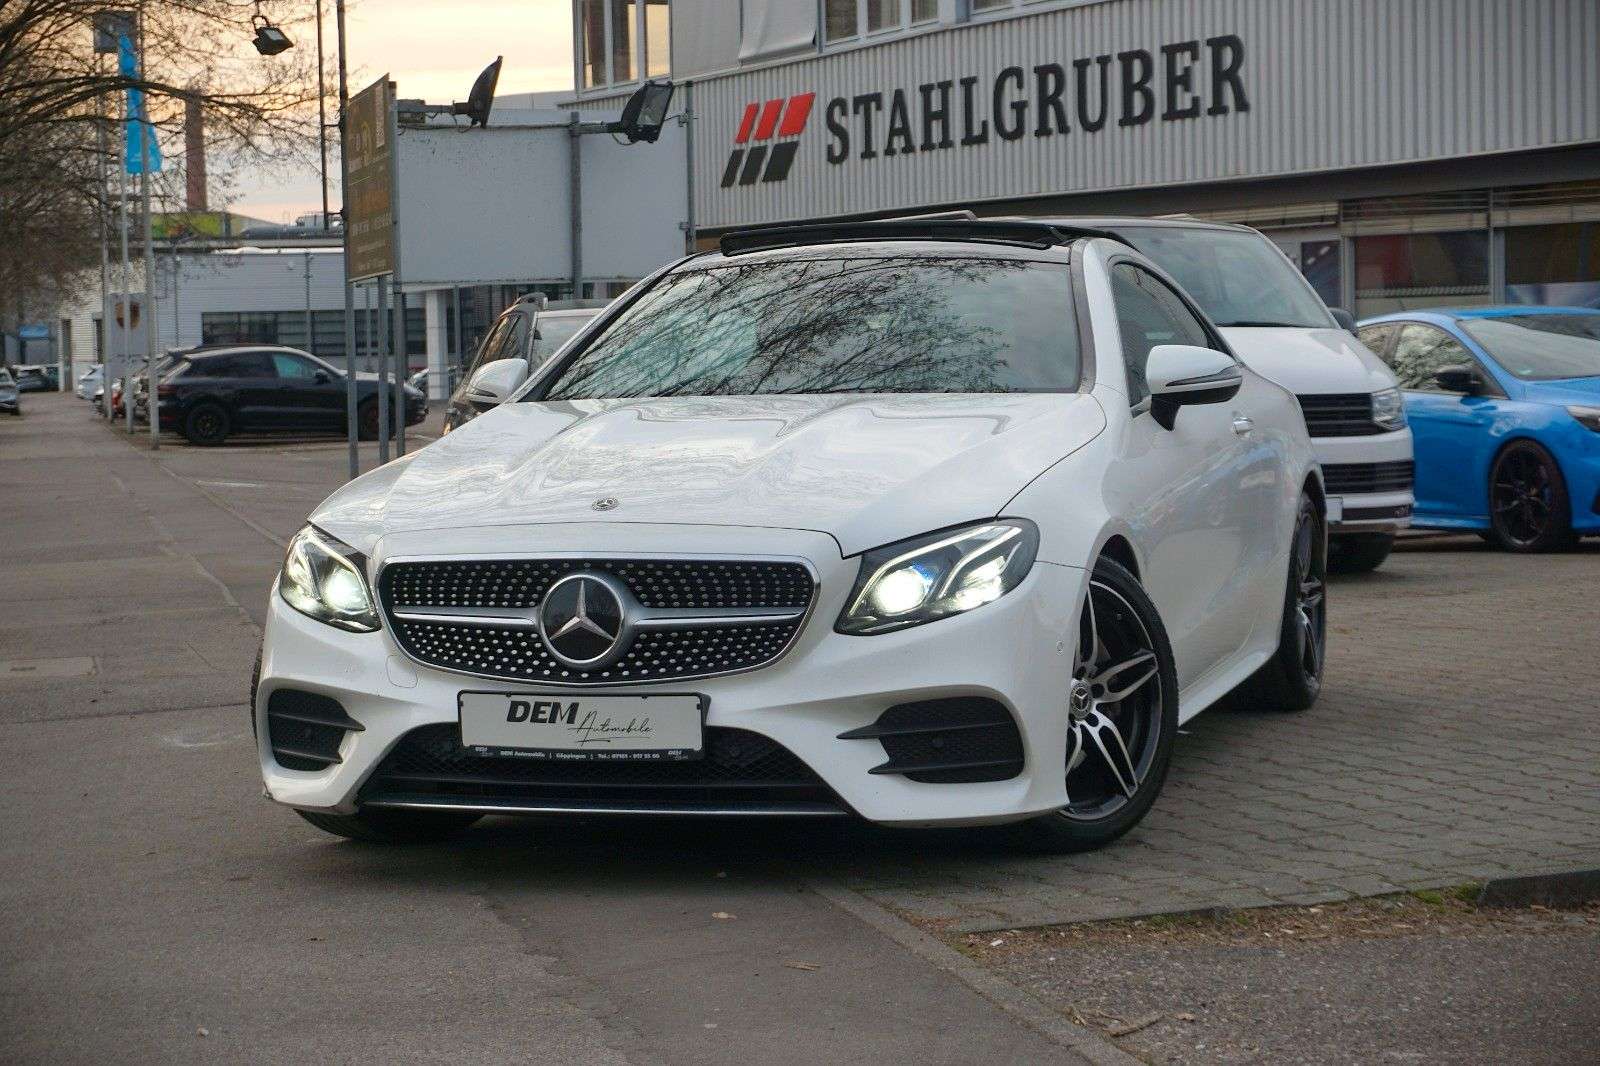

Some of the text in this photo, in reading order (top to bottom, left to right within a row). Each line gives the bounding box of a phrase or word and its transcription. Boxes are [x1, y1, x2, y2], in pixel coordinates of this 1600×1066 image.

[826, 35, 1250, 164] STAHLGRUBER
[506, 700, 579, 724] DEM
[567, 711, 652, 747] Automobile
